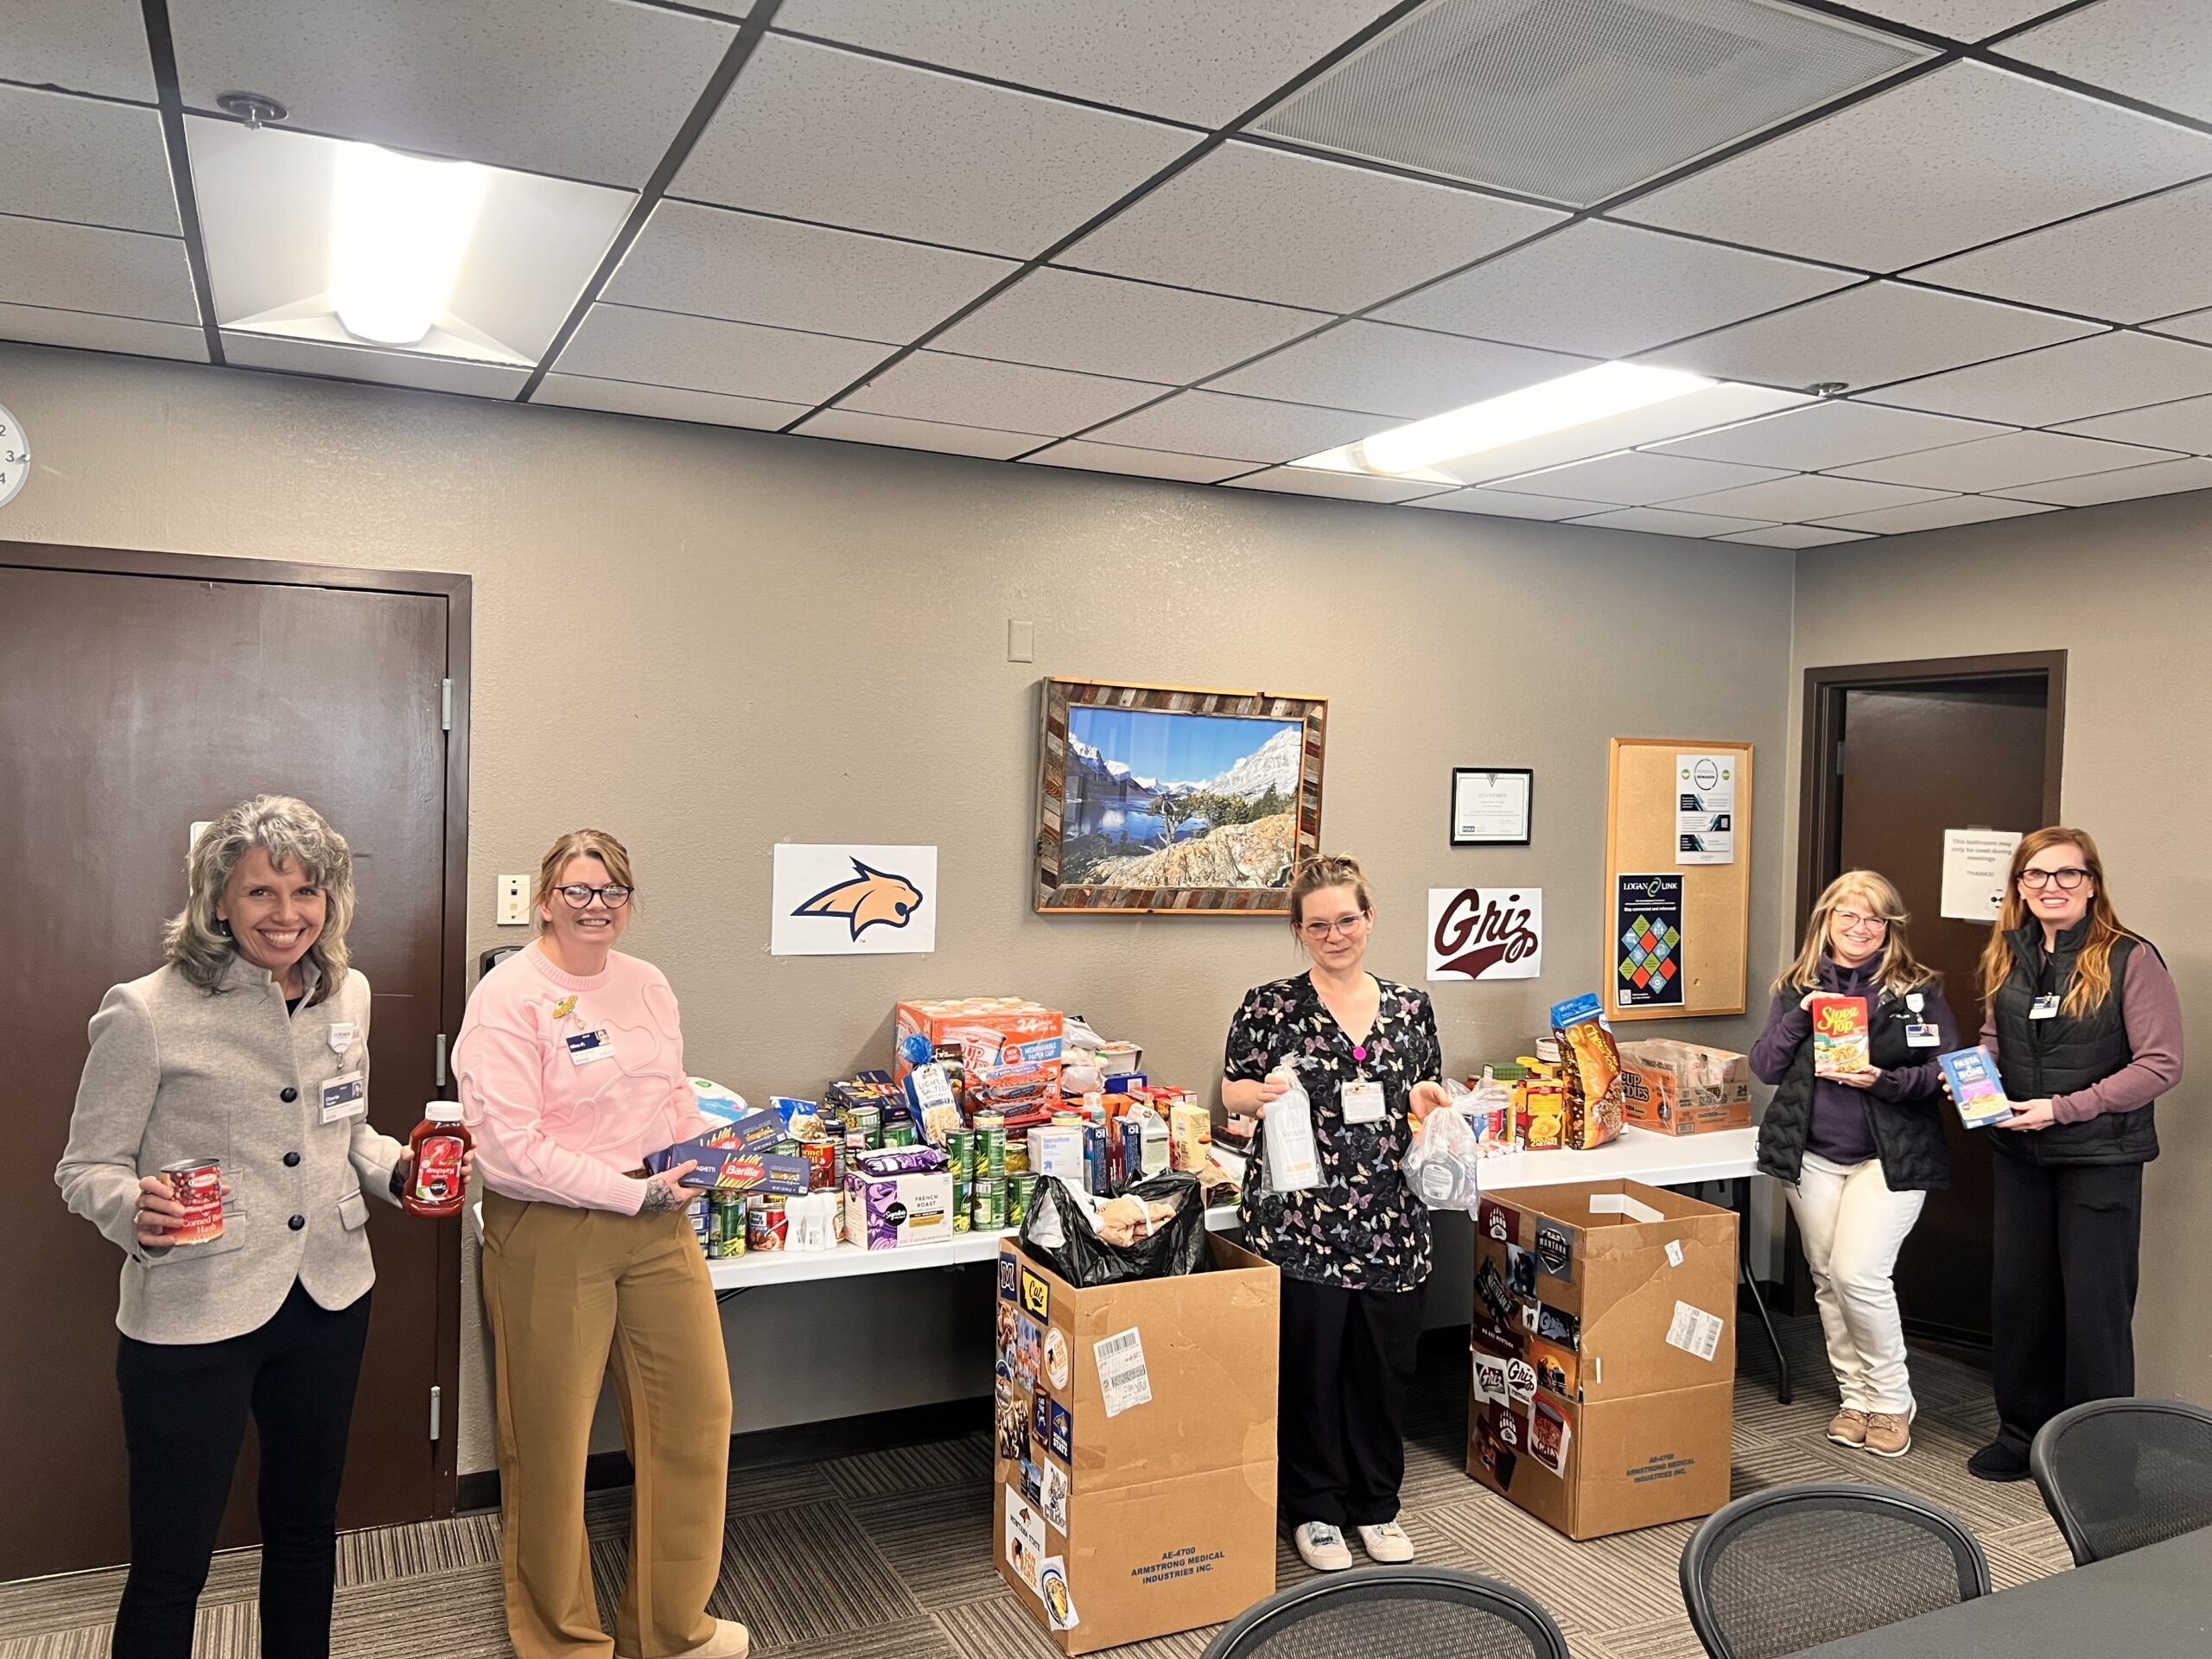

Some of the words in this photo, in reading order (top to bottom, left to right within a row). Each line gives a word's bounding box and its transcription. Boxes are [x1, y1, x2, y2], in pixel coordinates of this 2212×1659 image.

[5, 450, 15, 462] 3
[1434, 888, 1538, 963] Griz
[1017, 1018, 1038, 1032] 24
[1817, 1007, 1859, 1031] Stove
[1833, 1020, 1853, 1035] Top
[1045, 1049, 1055, 1058] CUP
[1955, 1056, 1980, 1069] PASTA
[1958, 1066, 1985, 1080] RONI
[1737, 1085, 1748, 1094] 24
[725, 1165, 760, 1178] Barilla
[182, 1217, 212, 1227] Corned
[197, 1224, 216, 1234] Hash
[1539, 1237, 1567, 1254] MONTANA
[1001, 1262, 1015, 1292] M
[1028, 1280, 1045, 1304] Cats
[1479, 1366, 1502, 1387] Griz
[1508, 1360, 1535, 1391] Griz
[1010, 1514, 1028, 1539] MONTANA
[1028, 1534, 1040, 1552] STATE
[1162, 1547, 1196, 1560] AE-4700
[1130, 1559, 1185, 1576] ARMSTRONG
[1187, 1551, 1225, 1564] MEDICAL
[1142, 1567, 1194, 1584] INDUSTRIES
[1196, 1563, 1214, 1573] INC.
